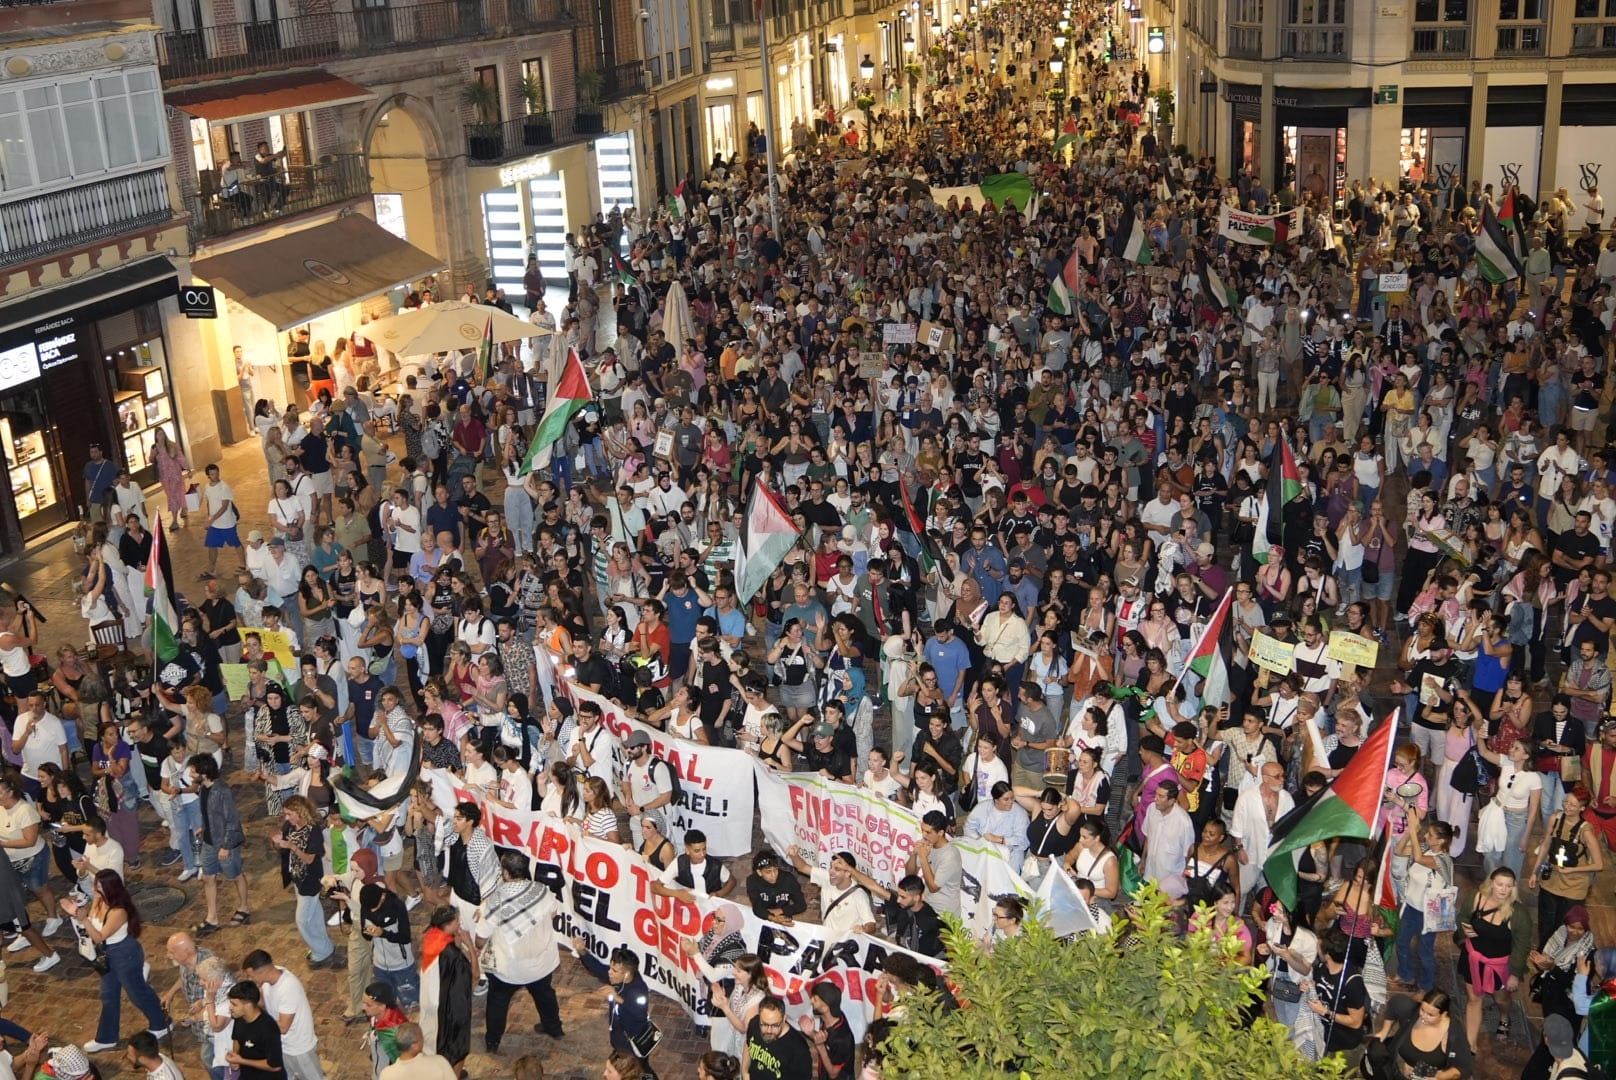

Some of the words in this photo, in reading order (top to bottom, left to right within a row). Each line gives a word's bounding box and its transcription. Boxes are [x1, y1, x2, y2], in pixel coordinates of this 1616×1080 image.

[1272, 96, 1298, 107] SECRET
[788, 785, 832, 836] FIN
[833, 802, 864, 825] DEL
[830, 836, 844, 850] EL
[832, 820, 853, 837] DE
[855, 826, 869, 847] LA
[552, 912, 609, 959] dicato
[643, 952, 711, 1016] Estudia
